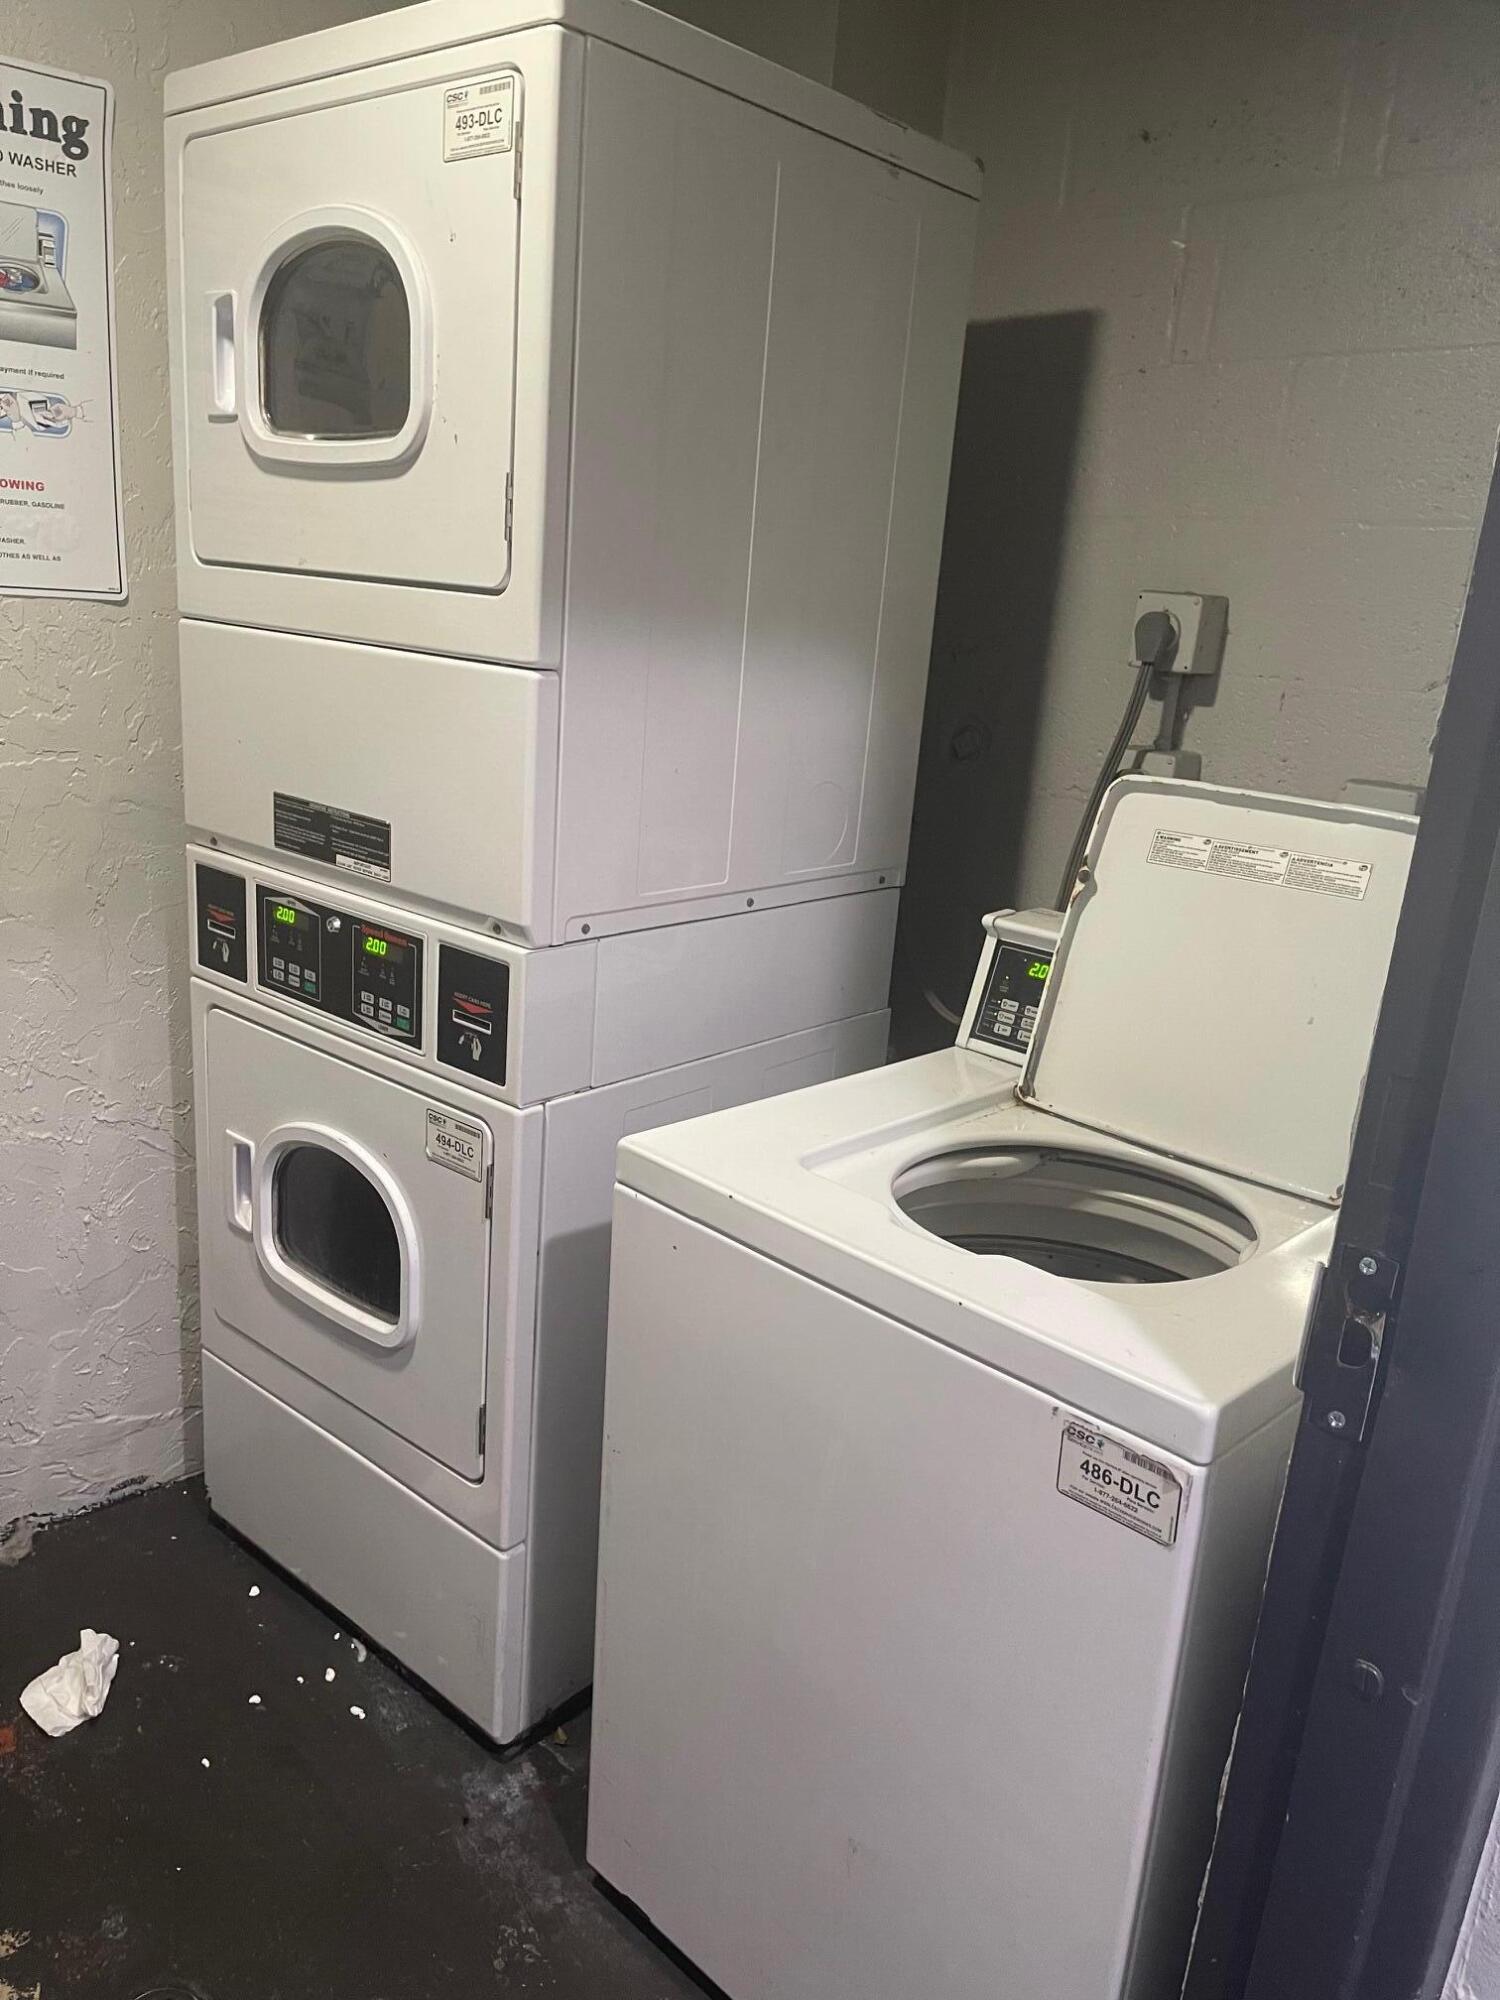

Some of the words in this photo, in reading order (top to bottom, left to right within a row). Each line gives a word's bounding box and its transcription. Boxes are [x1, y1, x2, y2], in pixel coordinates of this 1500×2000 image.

[455, 108, 503, 130] 493-DLC
[8, 151, 77, 178] WASHER
[17, 182, 44, 195] loosely
[34, 370, 65, 380] required
[0, 479, 45, 492] OWING
[0, 537, 26, 545] ASHER.
[435, 1133, 474, 1158] 494-DLC
[1067, 1426, 1095, 1444] CSC
[1080, 1459, 1160, 1509] 486-DLC
